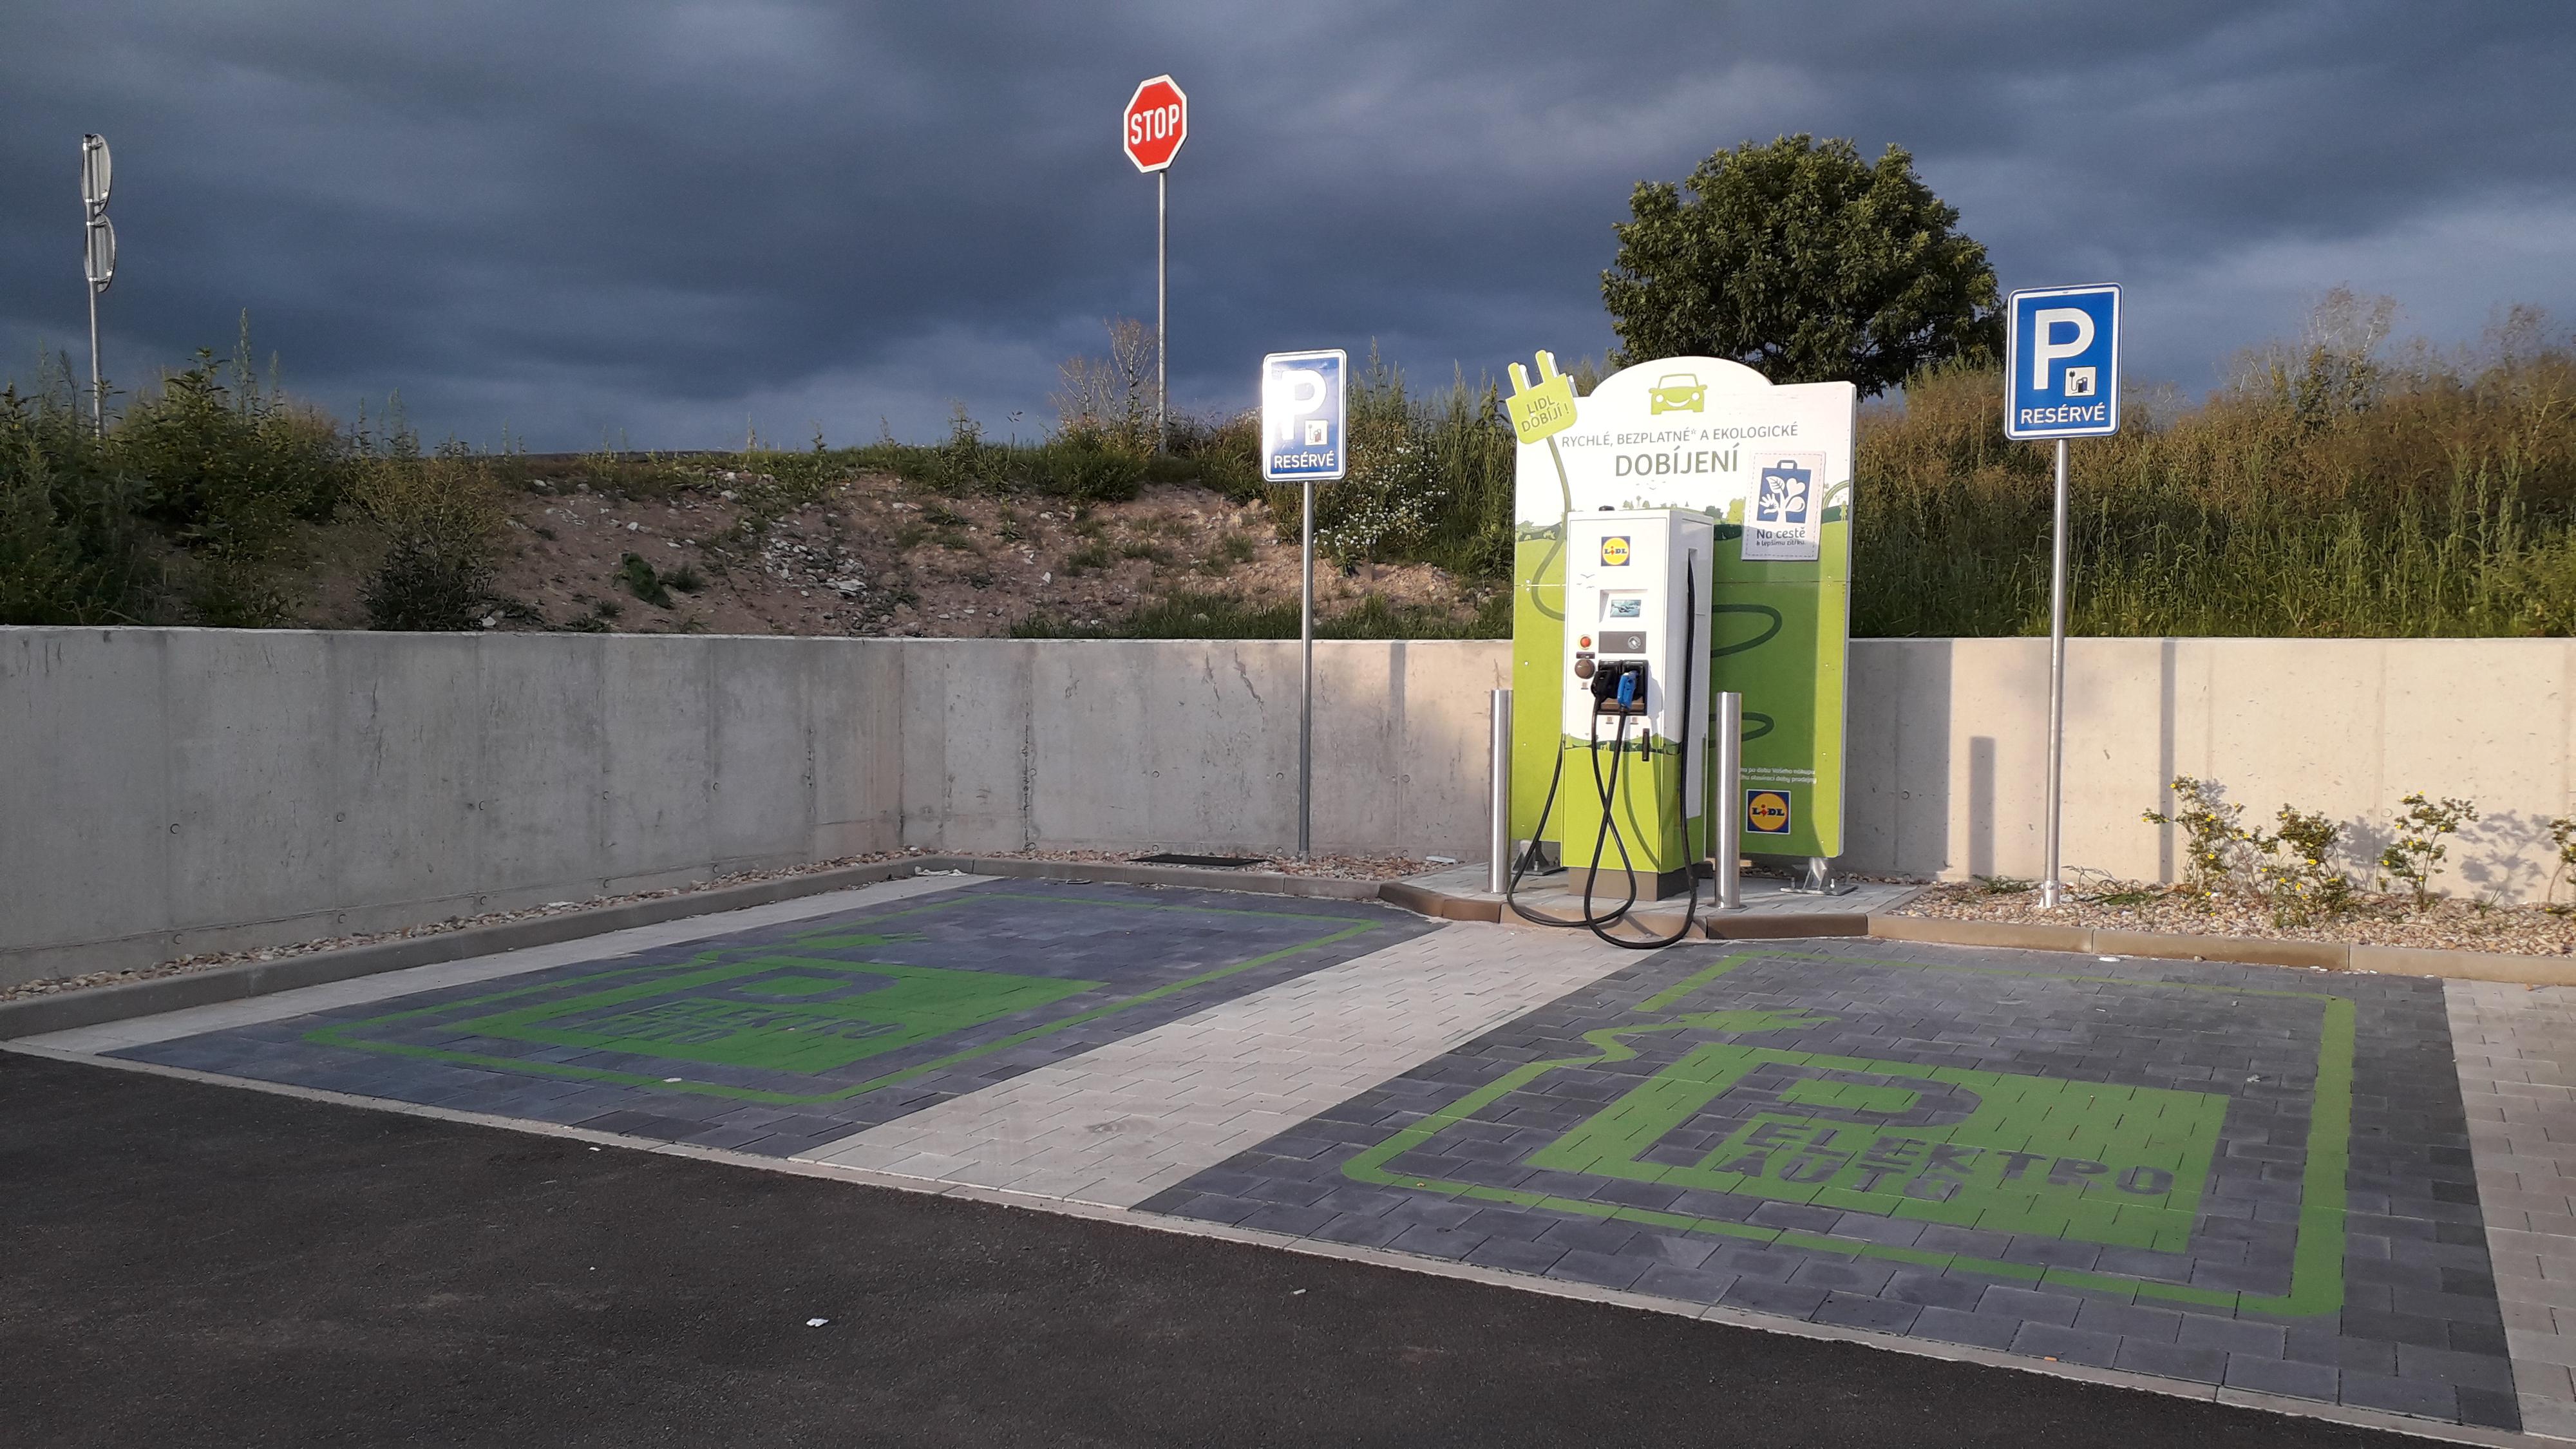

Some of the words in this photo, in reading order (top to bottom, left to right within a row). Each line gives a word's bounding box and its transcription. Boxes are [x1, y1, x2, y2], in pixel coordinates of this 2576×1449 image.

[1131, 104, 1180, 145] STOP
[2033, 307, 2095, 390] P
[1281, 369, 1327, 440] P
[1527, 395, 1555, 414] LIDL
[2021, 402, 2106, 424] RESÉRVÉ
[1562, 431, 1613, 447] RYCHLÉ,
[1700, 428, 1709, 441] A
[1713, 421, 1799, 440] EKOLOGICKÉ
[1274, 451, 1334, 469] RESÉRVÉ
[1615, 444, 1740, 477] DOBÍJENÍ
[1757, 529, 1772, 539] Na
[1776, 527, 1806, 539] cestě
[1630, 1062, 1983, 1168] P
[1710, 1150, 1964, 1202] AUTO
[1743, 1122, 2175, 1195] ELEKTRO
